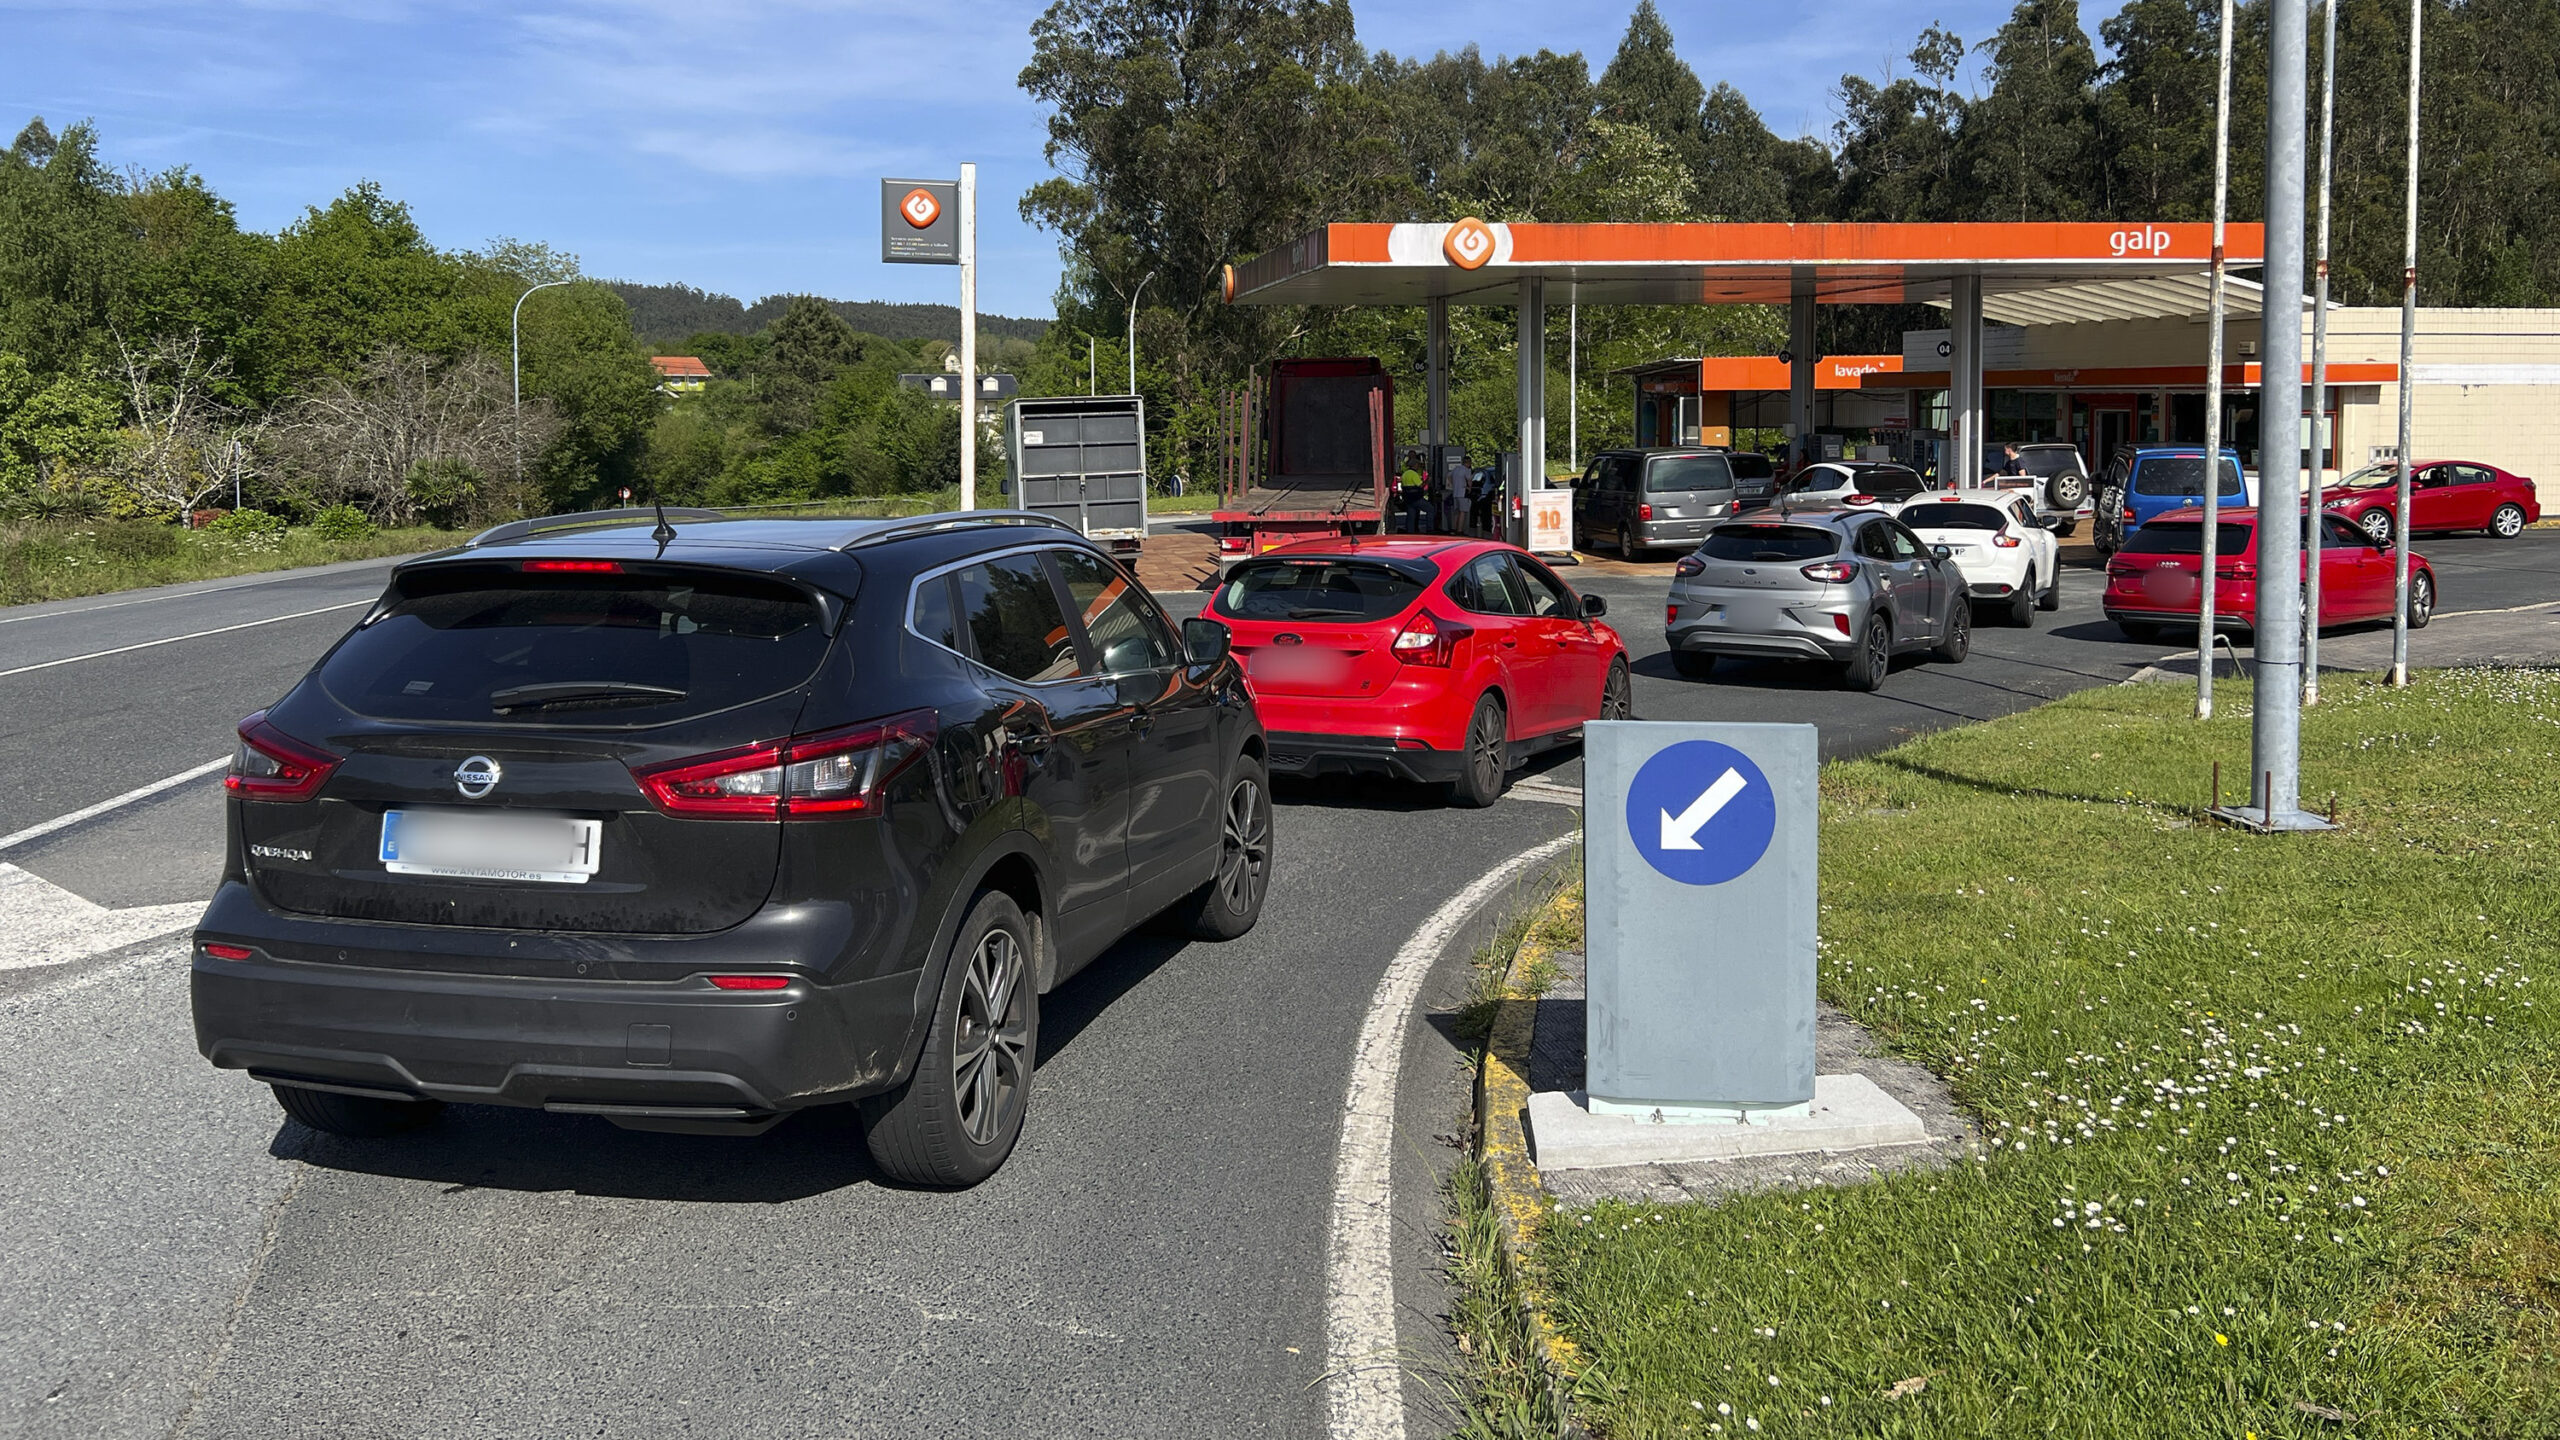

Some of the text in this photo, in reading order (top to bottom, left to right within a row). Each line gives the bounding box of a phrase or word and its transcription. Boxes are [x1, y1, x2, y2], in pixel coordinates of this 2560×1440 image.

[2109, 225, 2171, 256] galp
[1939, 344, 1950, 354] 04
[1834, 364, 1878, 377] lavado
[1537, 509, 1561, 530] 10
[457, 772, 494, 782] NISSAN
[250, 844, 313, 861] QASHQAI
[386, 840, 395, 852] E
[431, 866, 542, 881] www.ANTAMOTOR.es
